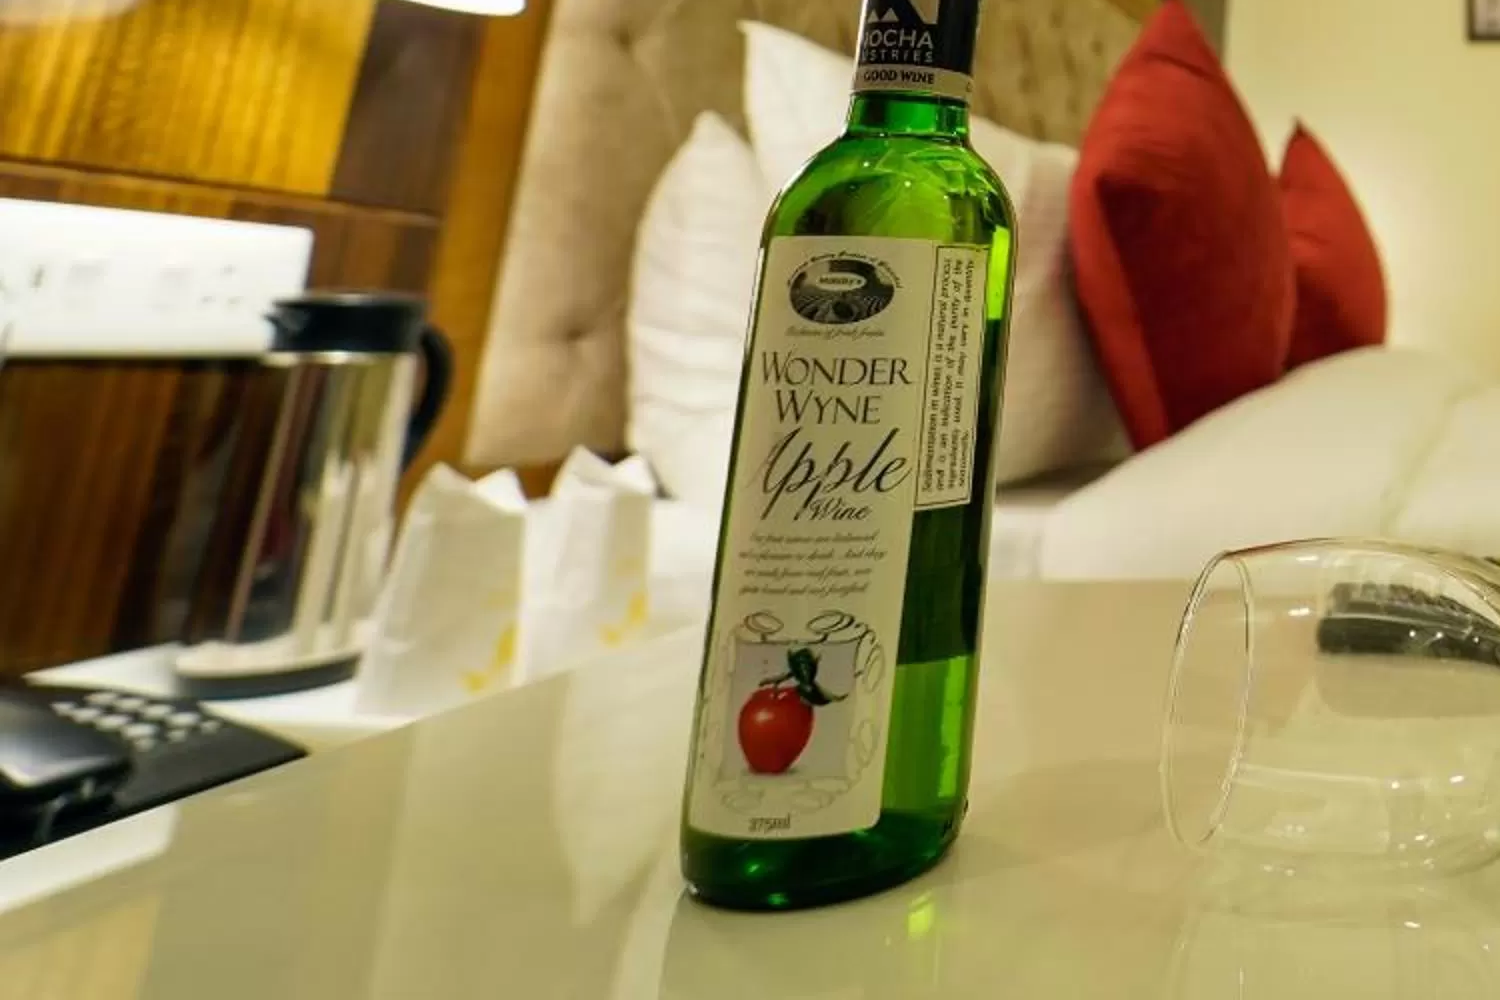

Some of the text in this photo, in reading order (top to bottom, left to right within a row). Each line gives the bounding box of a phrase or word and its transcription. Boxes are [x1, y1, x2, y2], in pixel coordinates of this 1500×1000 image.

[863, 69, 935, 85] GOOD WINE
[762, 350, 913, 386] WONDER
[775, 389, 882, 425] WYNE
[750, 427, 913, 520] Apple
[808, 498, 873, 521] Wine
